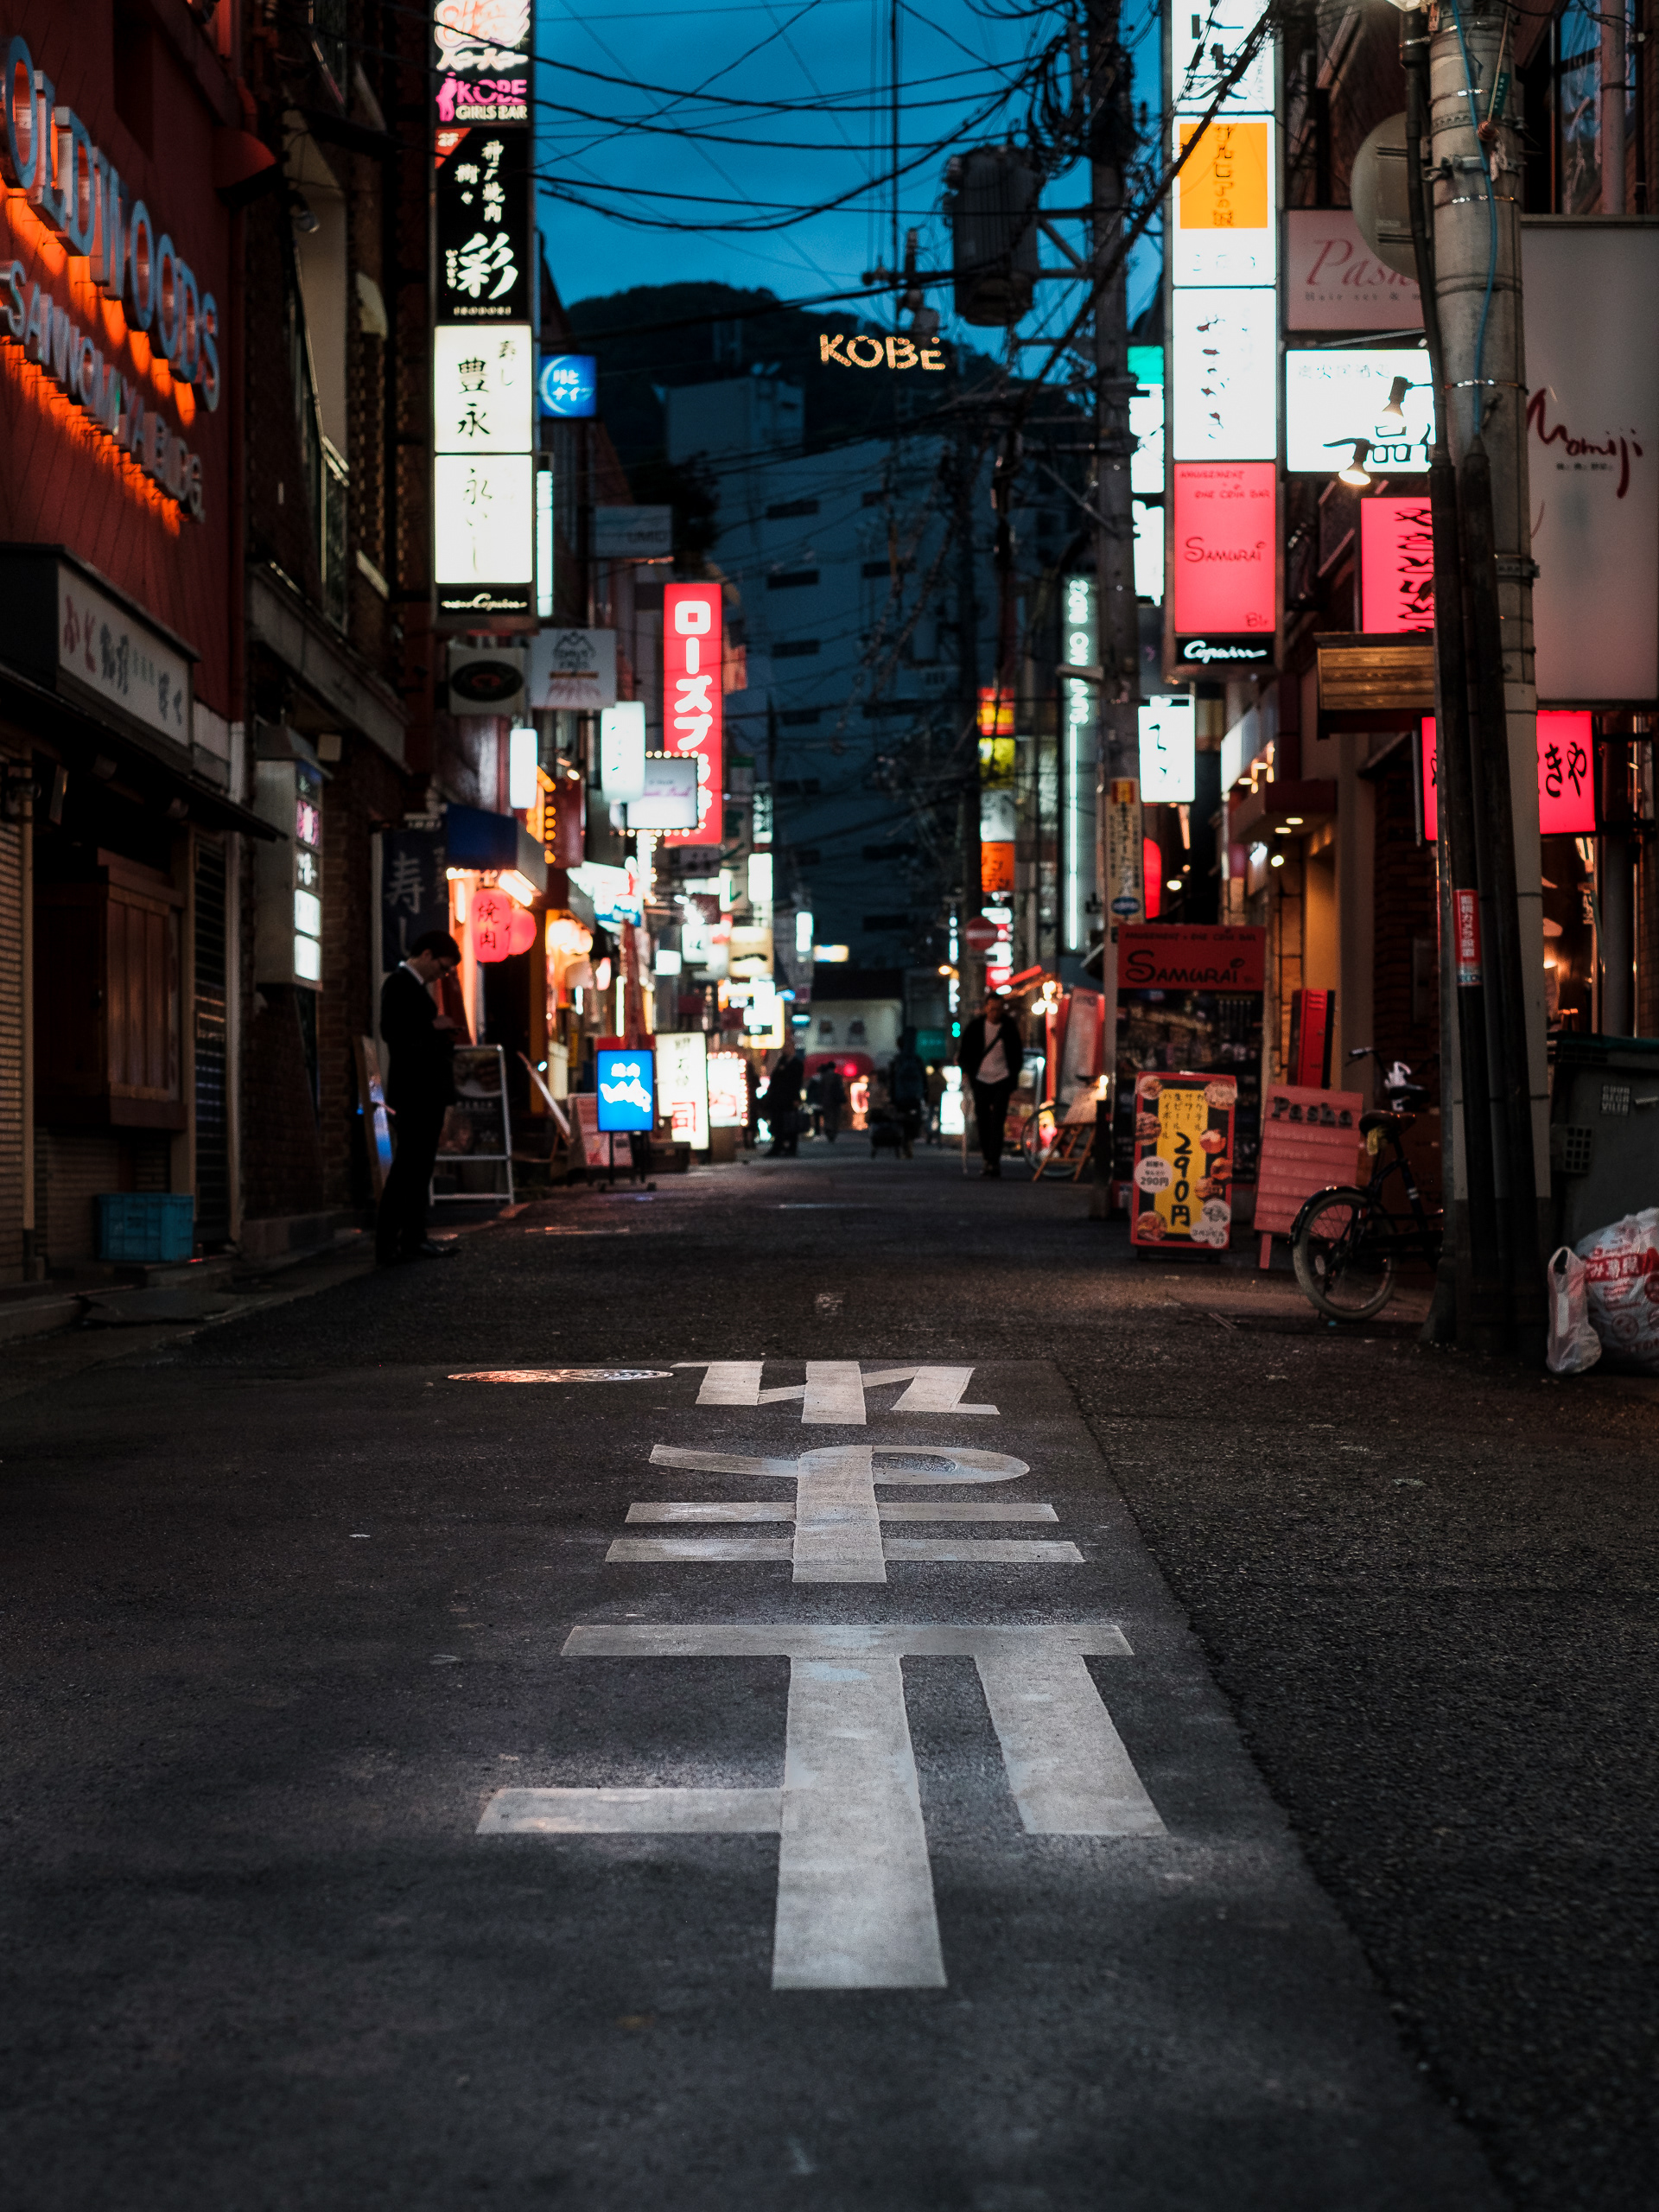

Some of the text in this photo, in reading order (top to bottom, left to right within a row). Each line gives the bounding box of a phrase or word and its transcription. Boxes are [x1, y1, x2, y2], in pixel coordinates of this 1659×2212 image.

[455, 105, 528, 121] GIRLS BAR
[457, 232, 518, 300] 彩
[820, 334, 946, 371] KOBE
[456, 354, 491, 439] 豊永
[1271, 1096, 1353, 1127] Pasha
[1140, 1176, 1170, 1189] 290円
[1171, 1132, 1193, 1228] 290円
[475, 1359, 1169, 1990] 止まれ
